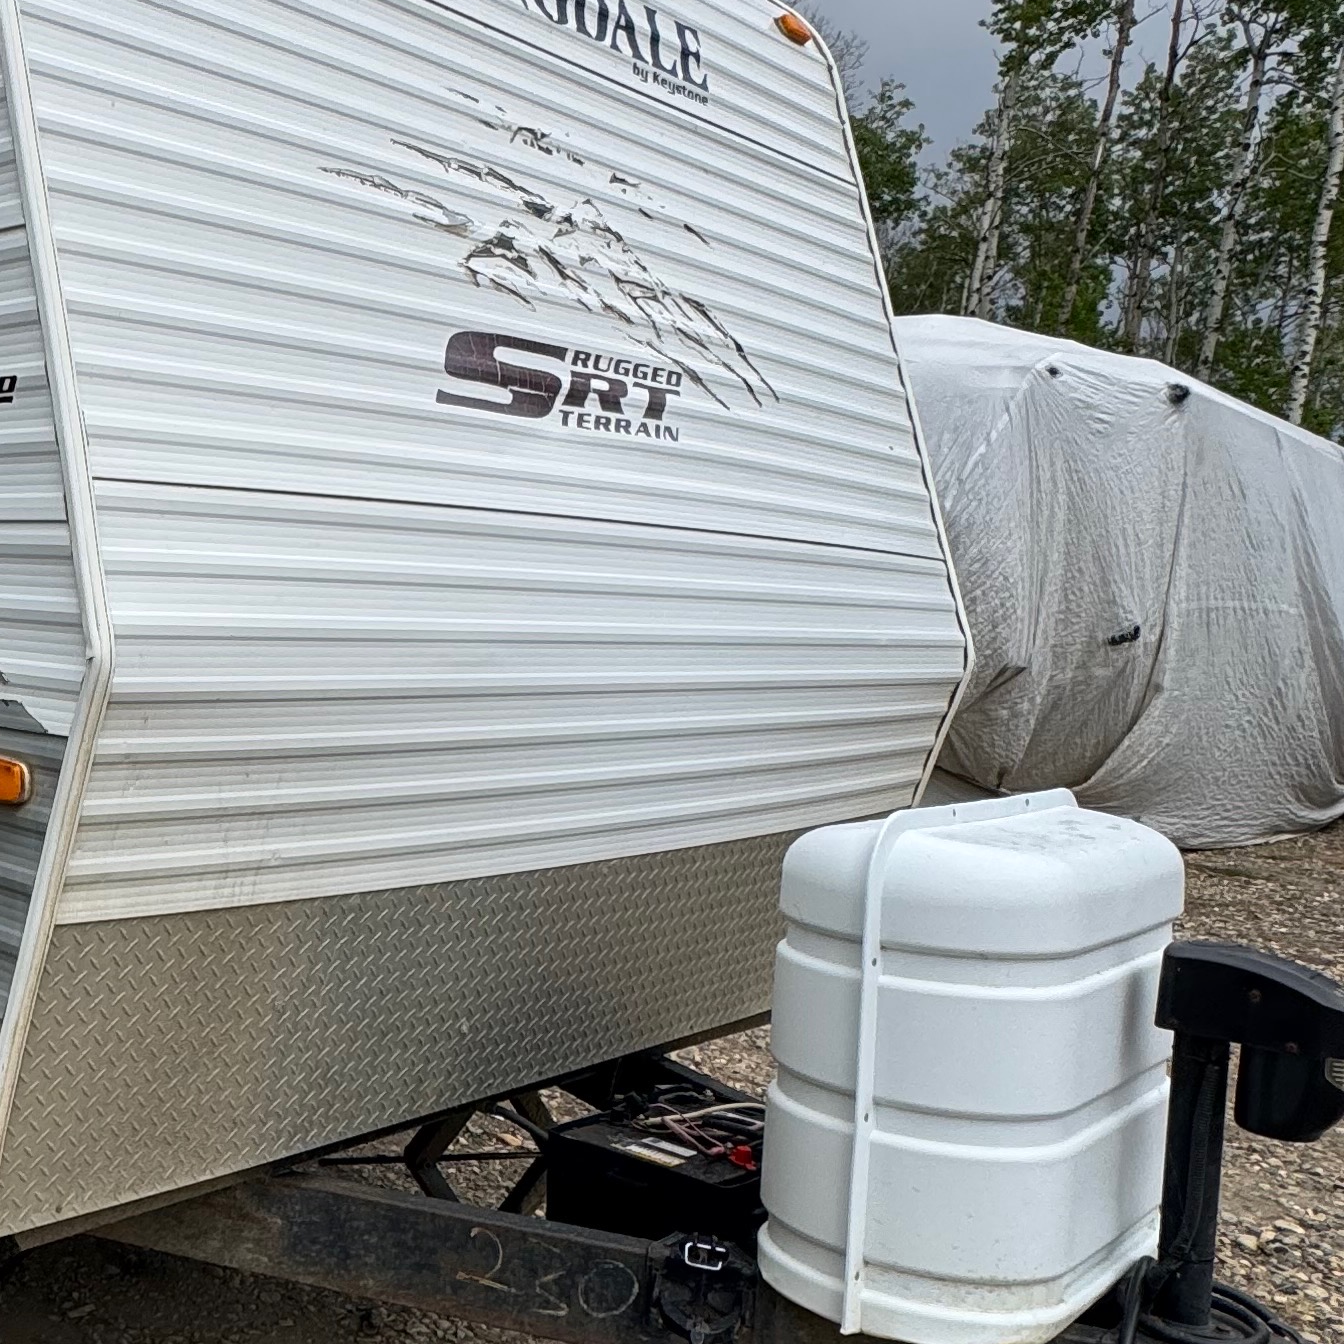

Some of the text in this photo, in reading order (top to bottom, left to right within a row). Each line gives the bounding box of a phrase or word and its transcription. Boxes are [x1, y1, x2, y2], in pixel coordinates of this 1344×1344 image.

[632, 62, 709, 107] by Keystone
[435, 330, 682, 420] SRT
[571, 349, 682, 388] RUGGED
[558, 409, 680, 443] TERRAIN
